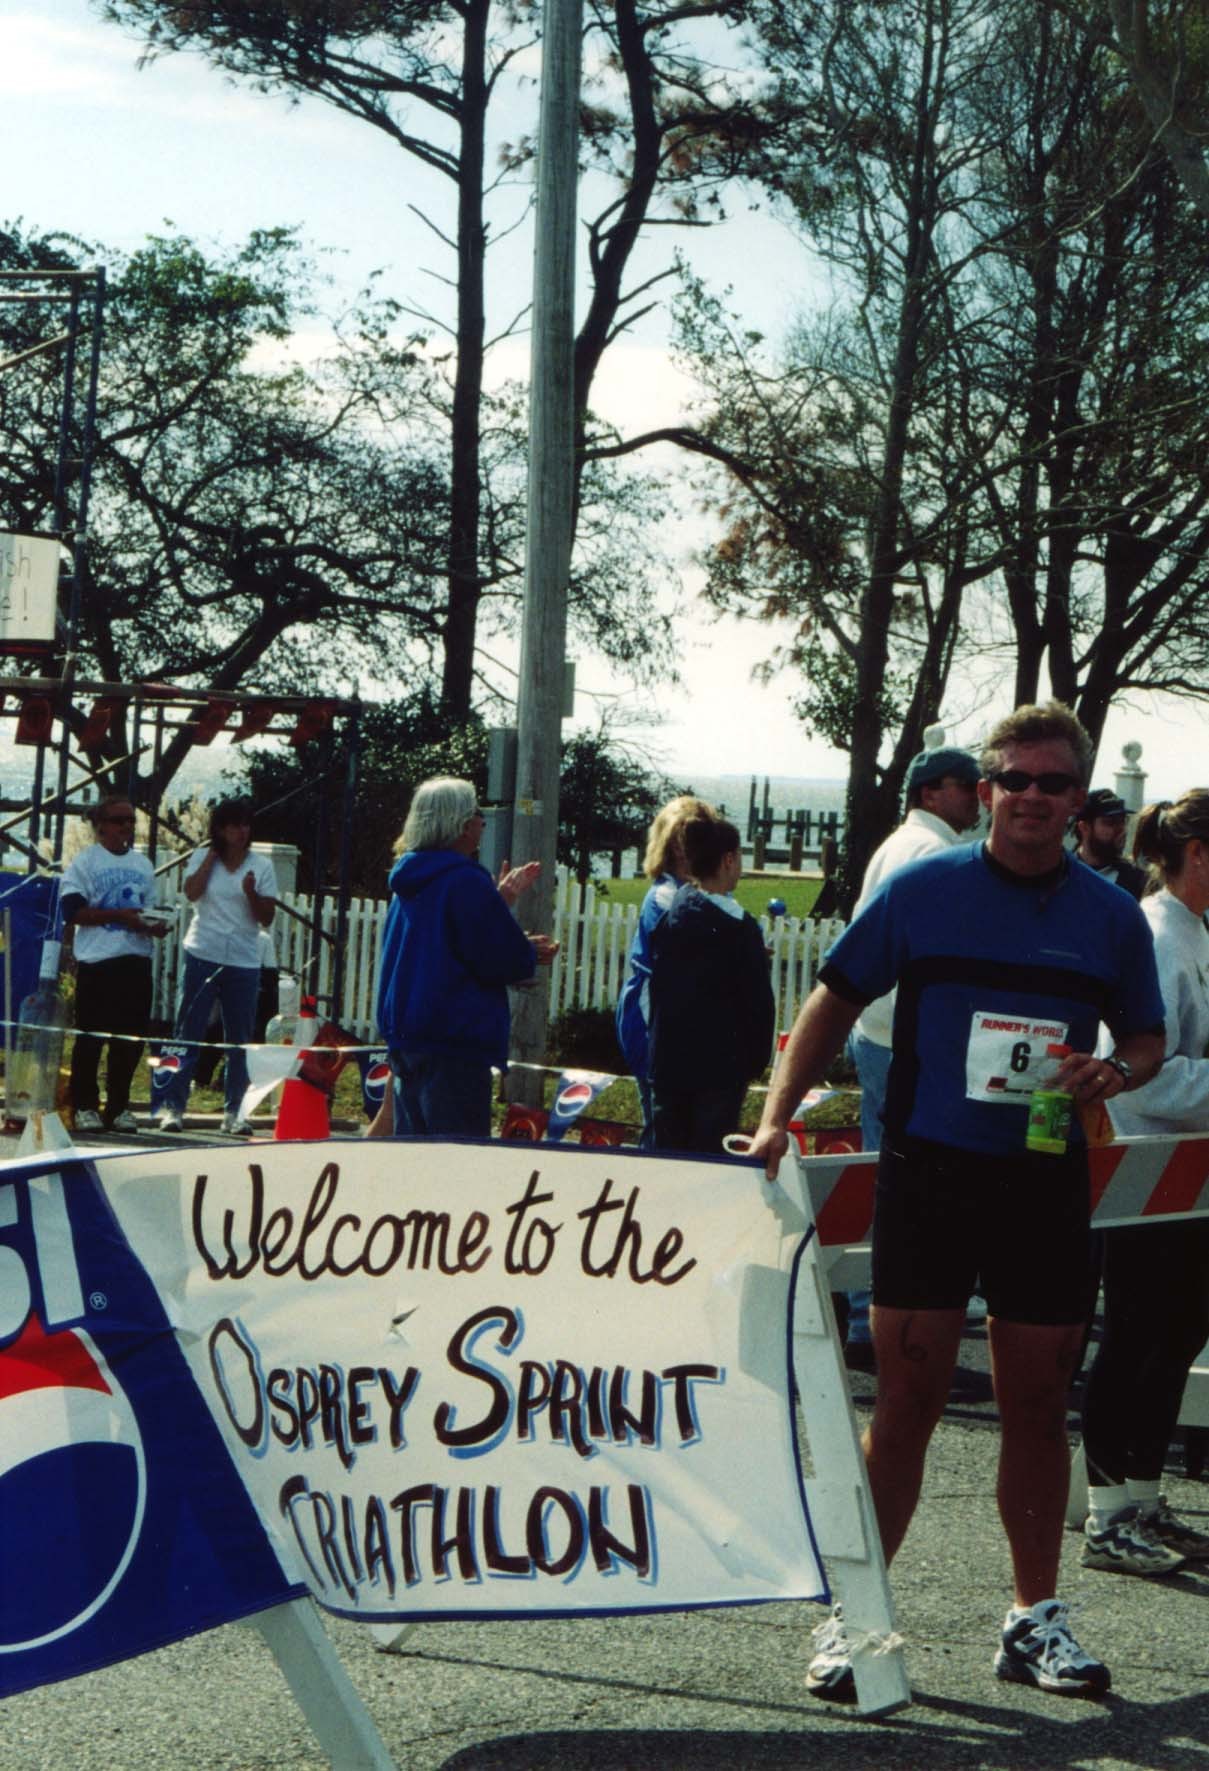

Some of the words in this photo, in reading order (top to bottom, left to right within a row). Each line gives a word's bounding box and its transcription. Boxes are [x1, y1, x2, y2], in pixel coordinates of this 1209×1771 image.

[981, 1018, 1030, 1034] RUNNER'S
[1010, 1041, 1031, 1074] 6
[193, 1162, 492, 1280] Welcome
[503, 1169, 564, 1275] to
[578, 1178, 697, 1286] the
[209, 1317, 421, 1473] OSPREY
[433, 1305, 726, 1460] SPRINT
[279, 1475, 658, 1604] TRIATHLON
